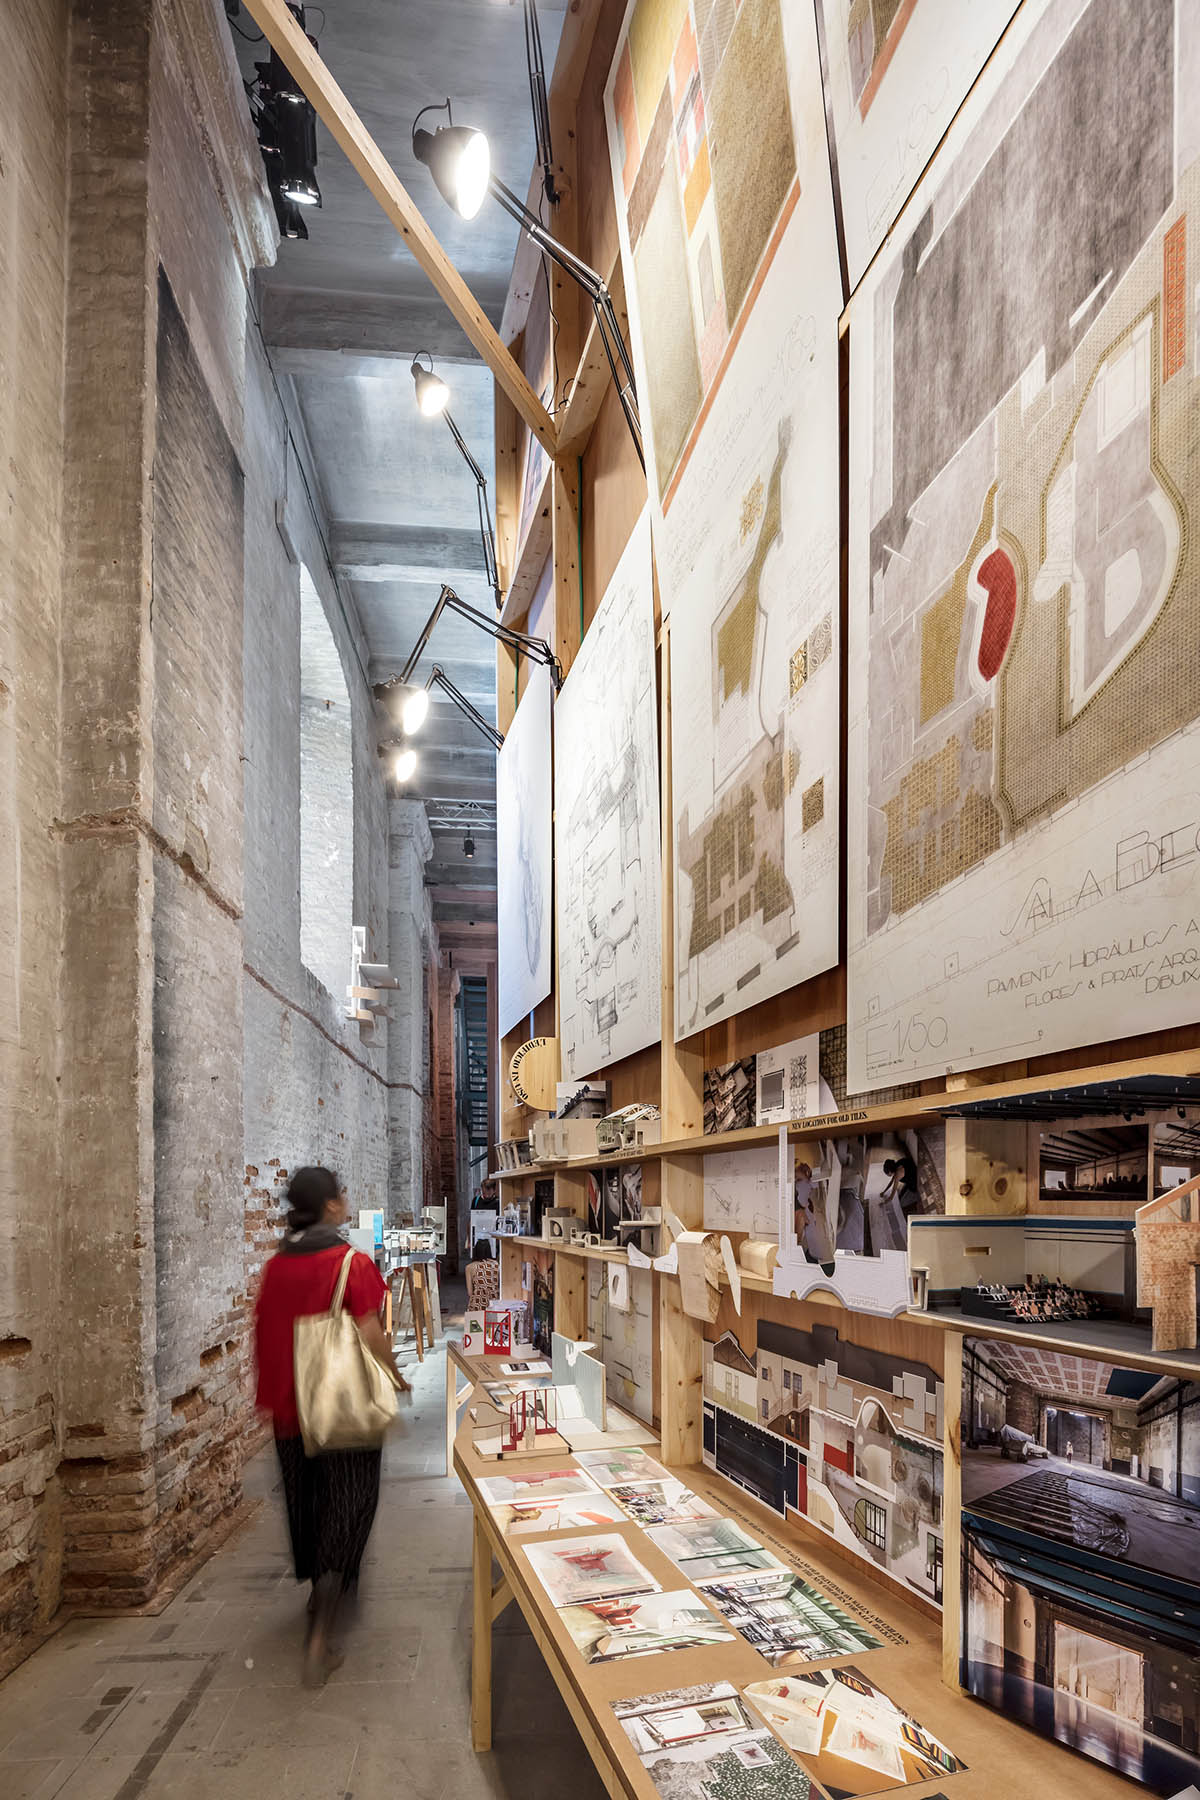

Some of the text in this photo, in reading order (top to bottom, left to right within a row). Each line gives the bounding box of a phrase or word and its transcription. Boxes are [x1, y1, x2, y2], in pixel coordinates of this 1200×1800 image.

[1116, 822, 1200, 891] BE
[512, 1071, 520, 1081] IN
[515, 1083, 529, 1100] USO
[791, 1122, 802, 1130] NEW
[802, 1119, 826, 1129] LOCATION
[826, 1116, 838, 1126] FOR
[838, 1114, 850, 1123] OLD
